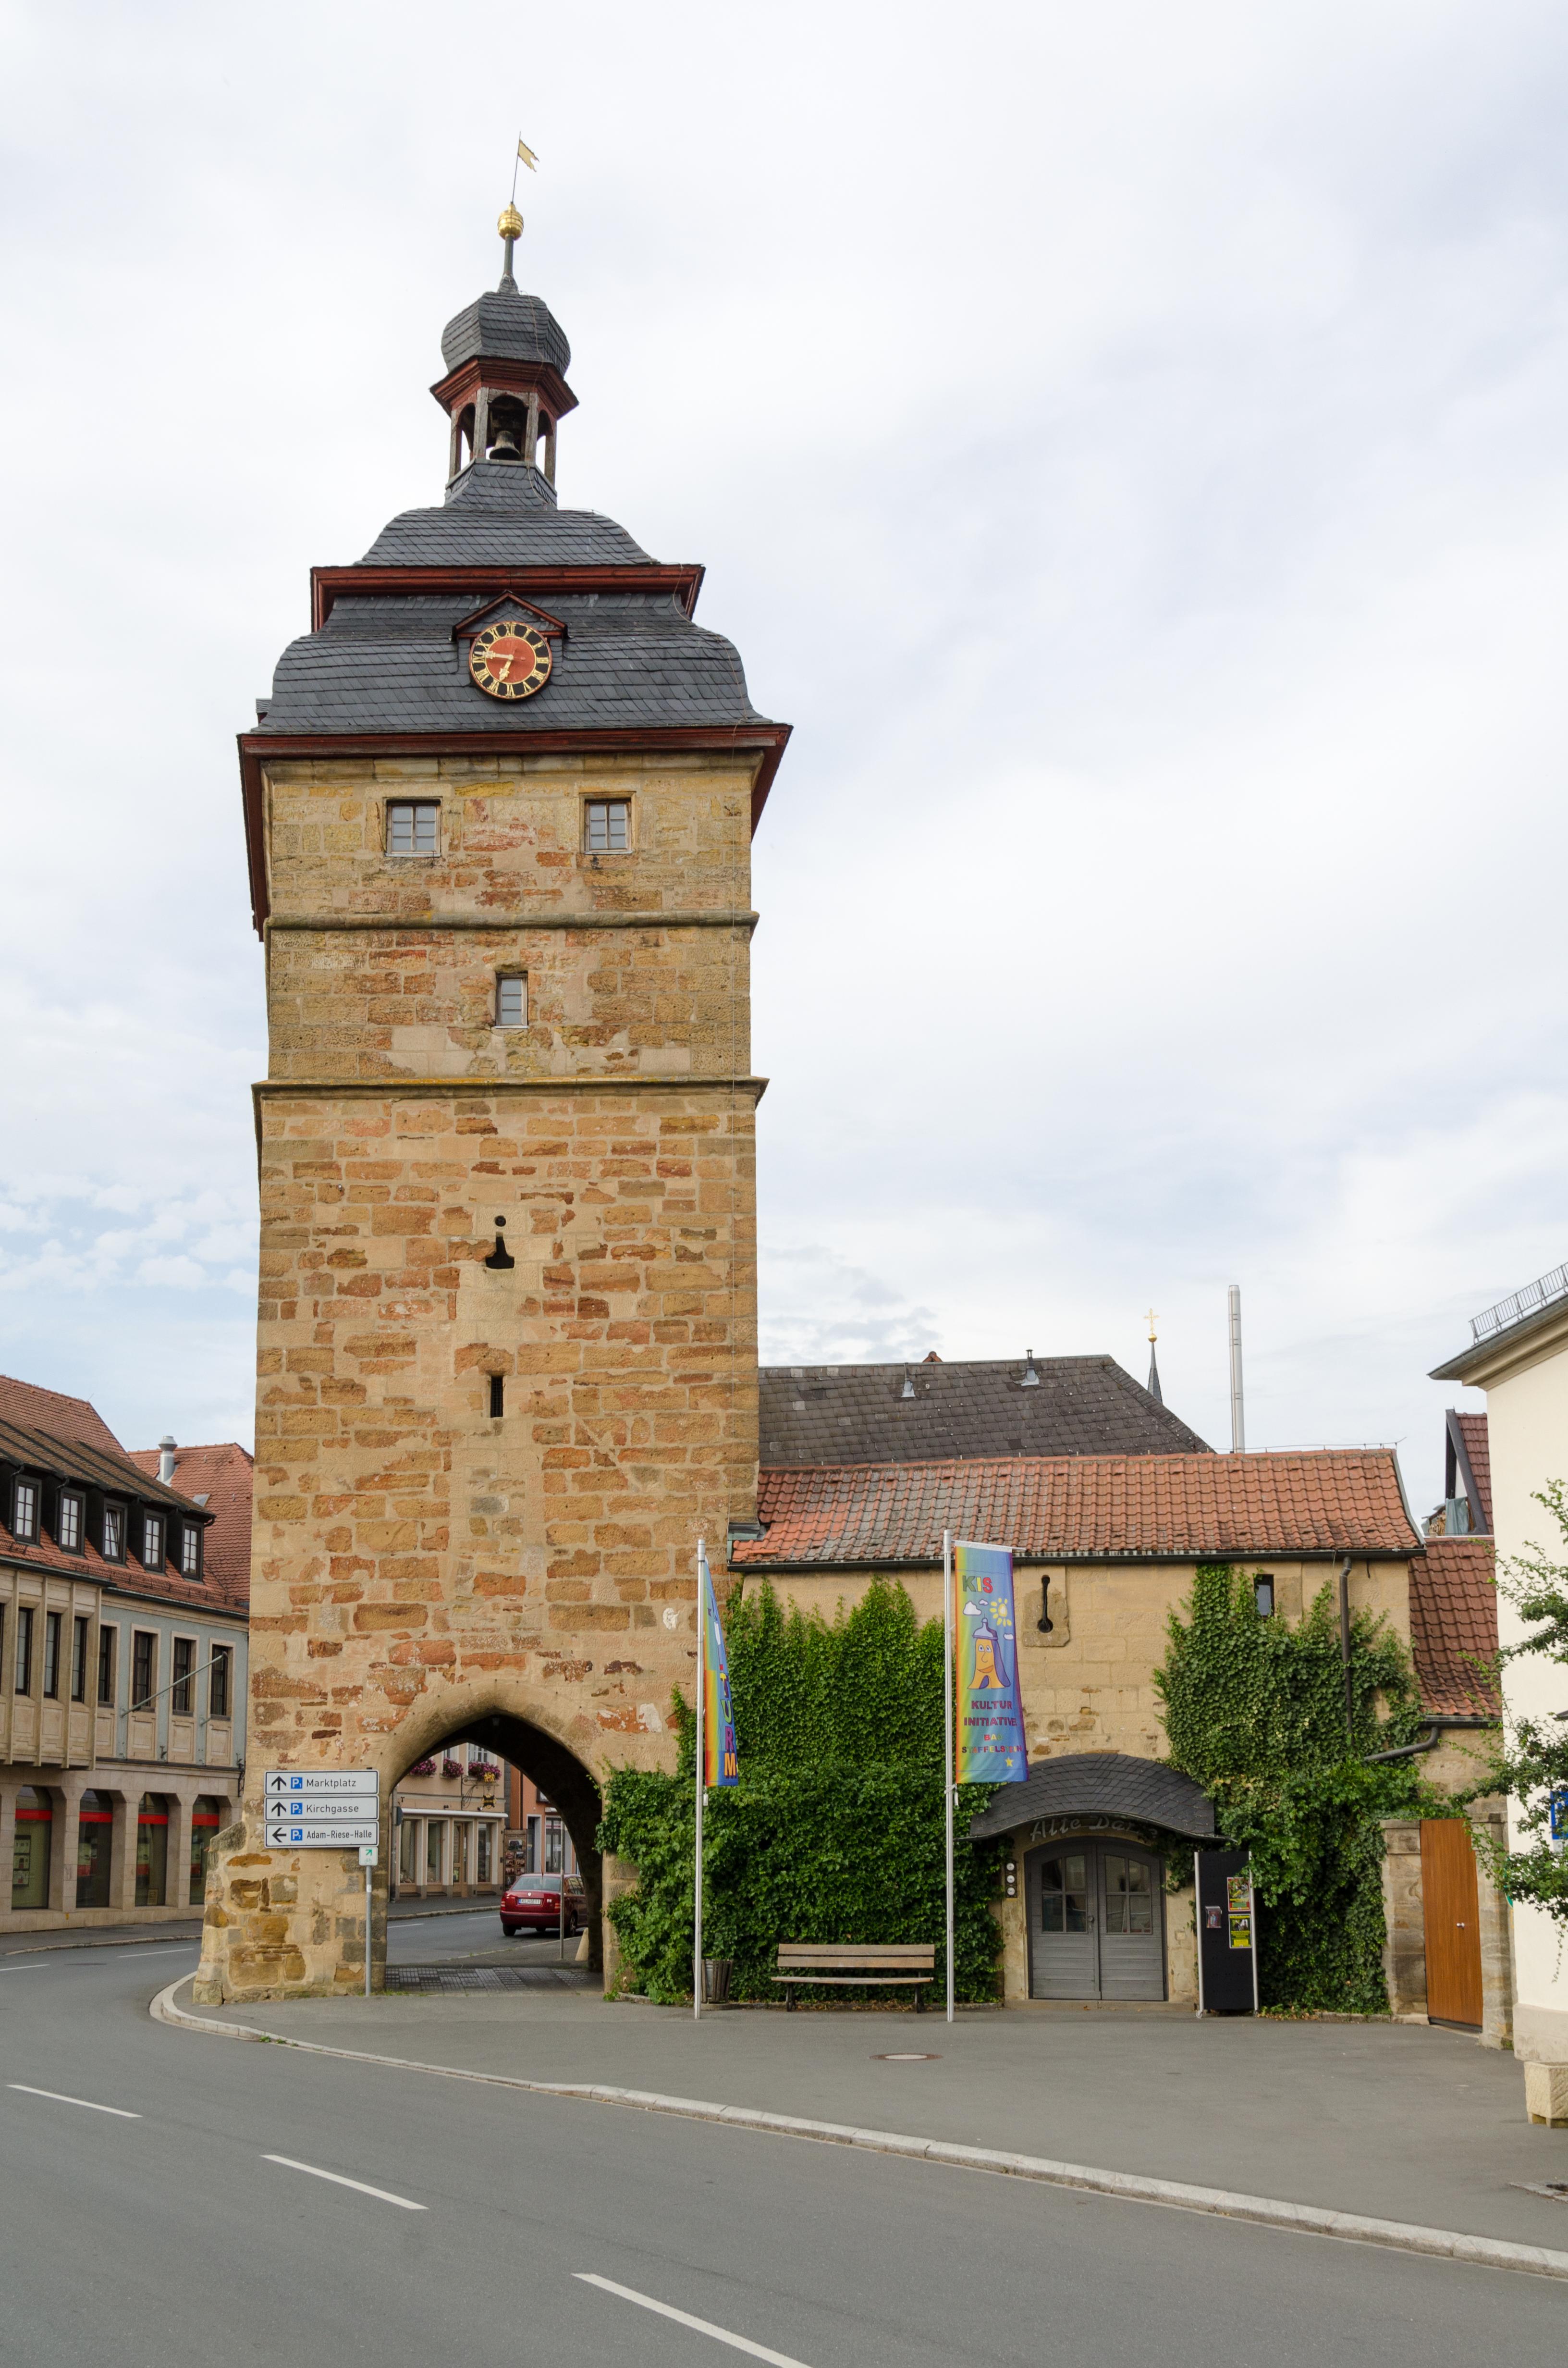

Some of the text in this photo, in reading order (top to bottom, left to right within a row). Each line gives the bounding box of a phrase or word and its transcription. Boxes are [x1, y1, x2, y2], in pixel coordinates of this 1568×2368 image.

[962, 1575, 993, 1594] KIS
[971, 1700, 1013, 1710] KULTUR
[964, 1716, 1017, 1727] INITIATIVE
[961, 1745, 1023, 1753] STAFFELSTEIN
[306, 1779, 357, 1789] Marktplatz
[306, 1804, 359, 1815] Kirchgasse
[306, 1830, 372, 1839] Adam-Riese-Halle
[1030, 1817, 1081, 1842] Alte
